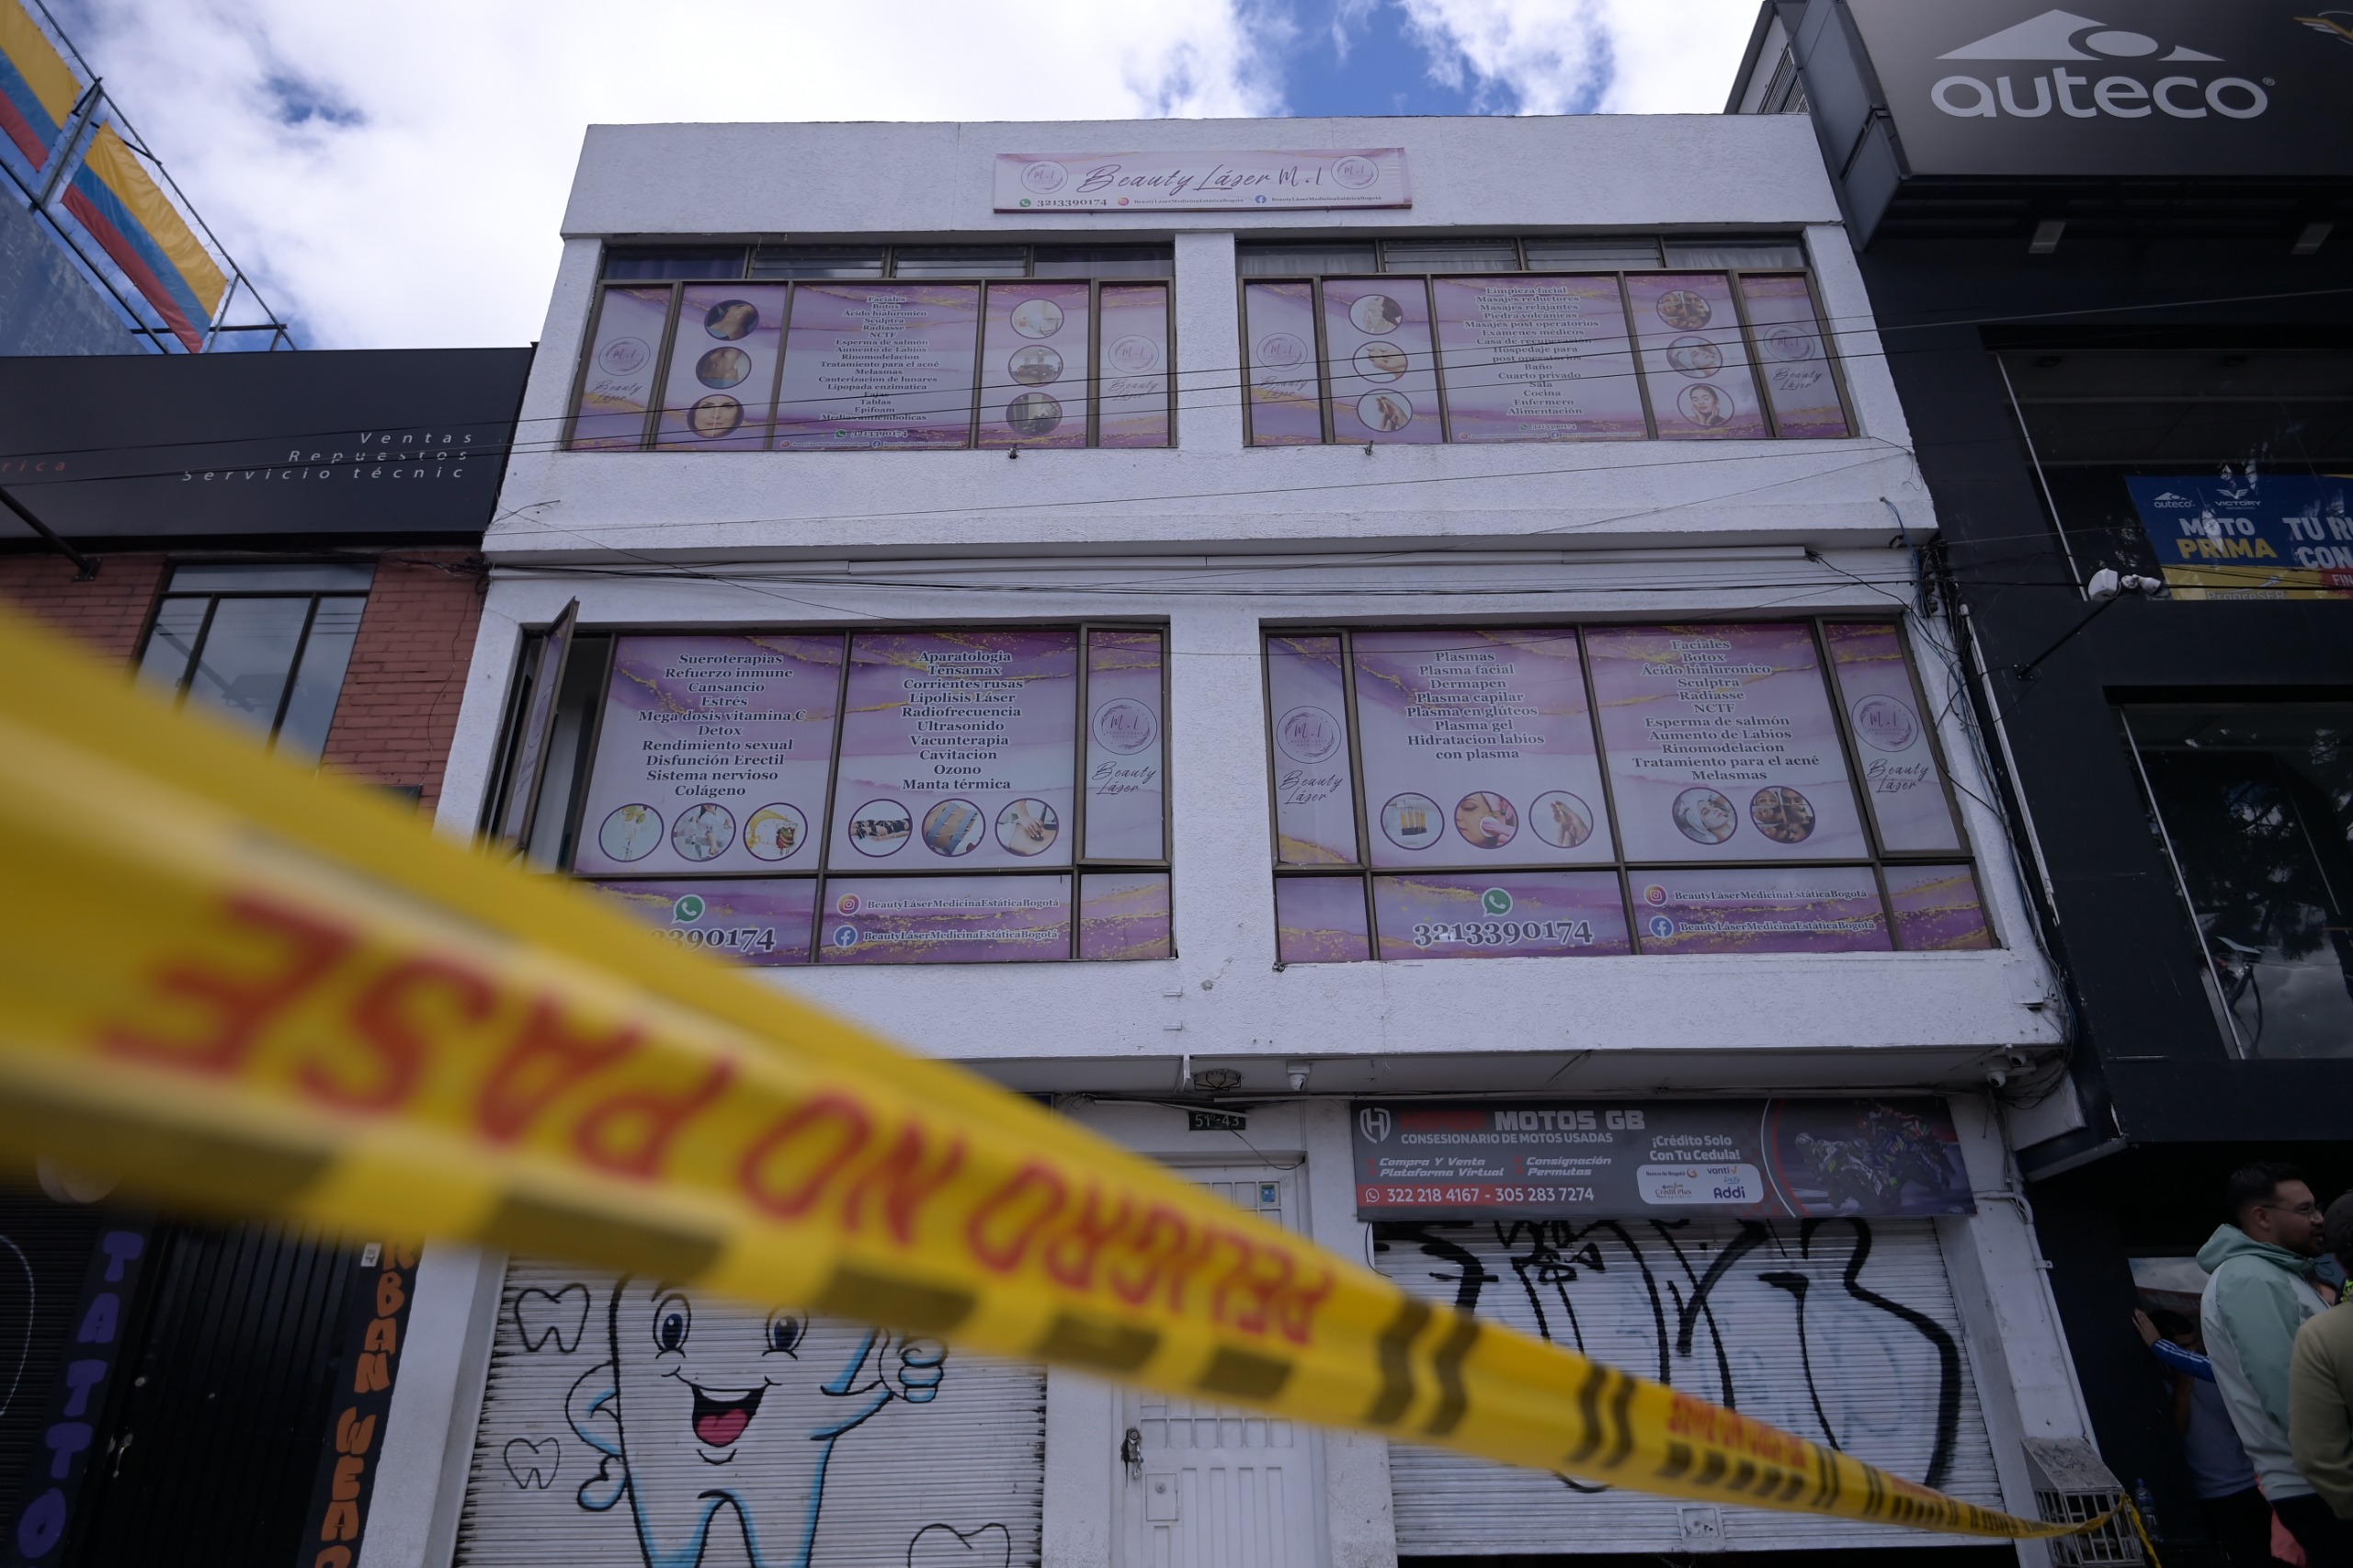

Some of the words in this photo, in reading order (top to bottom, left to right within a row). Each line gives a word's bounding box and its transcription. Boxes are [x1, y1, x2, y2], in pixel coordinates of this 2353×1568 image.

[1931, 67, 2268, 119] auteco
[1075, 164, 1196, 197] Beauty
[1192, 164, 1272, 191] Láser
[1037, 199, 1107, 207] 3213390174
[361, 432, 474, 444] Ventas
[182, 467, 331, 482] Servicio
[2178, 517, 2255, 536] MOTO
[2282, 517, 2325, 540] TU
[2176, 539, 2278, 559] PRIMA
[1671, 640, 1730, 650] Faciales
[678, 653, 783, 666] Sueroterapias
[918, 651, 1011, 664] Aparatologia
[1436, 652, 1495, 663] Plasmas
[1683, 653, 1726, 662] Botox
[665, 668, 732, 678] Refuerzo
[736, 668, 792, 678] inmune
[928, 665, 1001, 676] Tensamax
[1419, 665, 1472, 676] Plasma
[1475, 664, 1514, 675] facial
[1642, 664, 1683, 676] Ácido
[1686, 665, 1771, 674] hialuronico
[688, 682, 765, 692] Cansancio
[904, 678, 981, 690] Corrientes
[983, 679, 1023, 689] rusas
[1430, 679, 1506, 691] Dermapen
[1677, 677, 1740, 689] Sculptra
[701, 696, 747, 707] Estrés
[909, 693, 972, 704] Lipolisis
[975, 691, 1016, 703] Láser
[1416, 692, 1470, 703] Plasma
[1473, 692, 1524, 706] capilar
[1679, 690, 1745, 701] Radiasse
[902, 706, 1021, 717] Radiofrecuencia
[1405, 707, 1462, 718] Plasma
[1465, 708, 1482, 717] en
[1485, 705, 1537, 719] glúteos
[1694, 704, 1735, 713] NCTF
[638, 711, 678, 723] Mega
[681, 710, 722, 722] dosis
[724, 710, 791, 721] vitamina
[795, 710, 806, 721] C
[917, 721, 1004, 732] Ultrasonido
[1435, 721, 1488, 732] Plasma
[1492, 720, 1513, 733] gel
[1645, 717, 1711, 730] Esperma
[1714, 717, 1733, 727] de
[1736, 716, 1790, 726] salmón
[699, 725, 741, 736] Detox
[1649, 730, 1718, 741] Aumento
[1722, 730, 1739, 740] de
[1742, 729, 1791, 739] Labios
[910, 734, 1009, 748] Vacunterapia
[1407, 734, 1497, 745] Hidratacion
[1500, 733, 1545, 744] labios
[642, 740, 741, 751] Rendimiento
[745, 740, 793, 750] sexual
[1662, 743, 1784, 754] Rinomodelacion
[646, 754, 729, 766] Disfunción
[734, 755, 784, 766] Erectil
[920, 750, 996, 760] Cavitacion
[1436, 750, 1462, 759] con
[1467, 748, 1518, 762] plasma
[1633, 757, 1726, 767] Tratamiento
[1731, 758, 1764, 770] para
[1768, 756, 1782, 767] el
[1786, 756, 1819, 766] acné
[1868, 758, 1929, 780] Beauty
[646, 770, 708, 781] Sistema
[712, 770, 778, 781] nervioso
[934, 765, 982, 775] Ozono
[1092, 761, 1156, 784] Beauty
[1692, 770, 1767, 780] Melasmas
[902, 779, 949, 790] Manta
[954, 778, 1010, 790] térmica
[1279, 770, 1343, 791] Beauty
[675, 785, 745, 799] Colágeno
[1412, 919, 1594, 948] 3213390174
[96, 892, 742, 1183] PASE
[1495, 1110, 1597, 1131] MOTOS
[1606, 1110, 1645, 1130] GB
[1401, 1134, 1500, 1143] CONSESIONARIO
[1502, 1134, 1518, 1143] DE
[1520, 1133, 1563, 1143] MOTOS
[1564, 1132, 1612, 1143] USADAS
[1652, 1135, 1702, 1147] ¡Crédito
[1704, 1134, 1732, 1146] Solo
[1650, 1151, 1674, 1160] Con
[1676, 1151, 1691, 1160] Tu
[1693, 1149, 1741, 1160] Cedula!
[1380, 1158, 1430, 1167] Compra
[1449, 1157, 1485, 1165] Venta
[1526, 1156, 1611, 1167] Consignación
[737, 1084, 971, 1252] NO
[1460, 1167, 1504, 1176] Virtual
[1528, 1167, 1592, 1176] Permutas
[1707, 1166, 1730, 1175] vanti
[1388, 1189, 1414, 1202] 322
[1417, 1189, 1441, 1202] 218
[1447, 1188, 1479, 1202] 4167
[1495, 1188, 1523, 1201] 305
[1528, 1187, 1555, 1200] 283
[1561, 1187, 1594, 1200] 7274
[1713, 1186, 1745, 1199] Addi
[17, 1232, 144, 1568] TATTO
